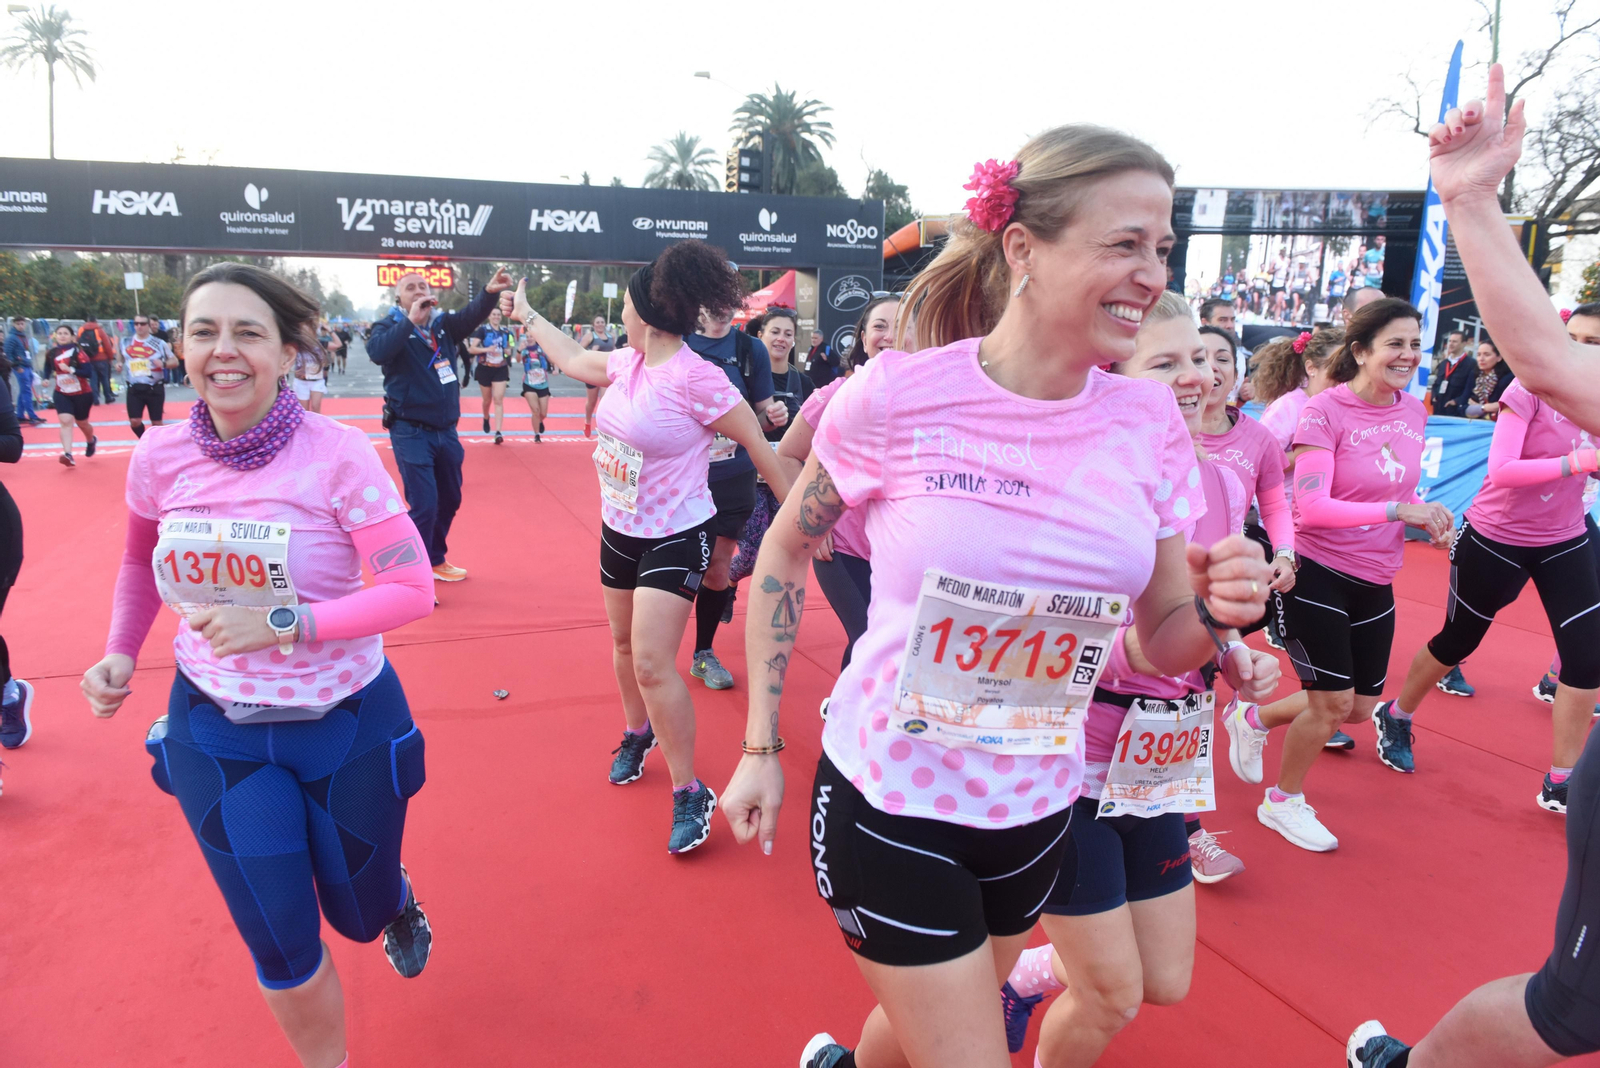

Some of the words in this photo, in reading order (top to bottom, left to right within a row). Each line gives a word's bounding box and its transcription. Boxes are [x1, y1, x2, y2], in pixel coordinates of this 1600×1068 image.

[92, 189, 180, 217] HOKA
[366, 197, 471, 219] maratón
[226, 226, 263, 235] Healthcare
[264, 227, 289, 235] Partner
[393, 215, 472, 236] sevilla
[529, 208, 601, 233] HOKA
[656, 219, 708, 231] HYUNDAI
[381, 237, 395, 248] 28
[396, 239, 427, 249] enero
[428, 239, 454, 250] 2024
[690, 231, 708, 239] Motor
[378, 267, 453, 287] 00::25
[1350, 424, 1380, 446] Corre
[1381, 424, 1391, 433] en
[1393, 420, 1424, 444] Rosa
[912, 427, 1043, 475] Marysol
[1223, 449, 1256, 477] Rosa
[925, 472, 987, 494] SEVILLA
[994, 479, 1031, 497] 2024
[230, 521, 271, 540] SEVILLA
[1449, 521, 1470, 561] WONG
[698, 531, 711, 571] WONG
[164, 549, 267, 588] 13709
[937, 575, 972, 599] MEDIO
[972, 584, 1025, 609] MARATÓN
[1046, 594, 1104, 619] SEVILLA
[912, 632, 924, 657] CAJÓN
[930, 617, 1078, 680] 13713
[976, 676, 1013, 687] Marysol
[975, 735, 1004, 745] HOKA
[1117, 726, 1200, 766] 13928
[812, 785, 834, 899] WONG
